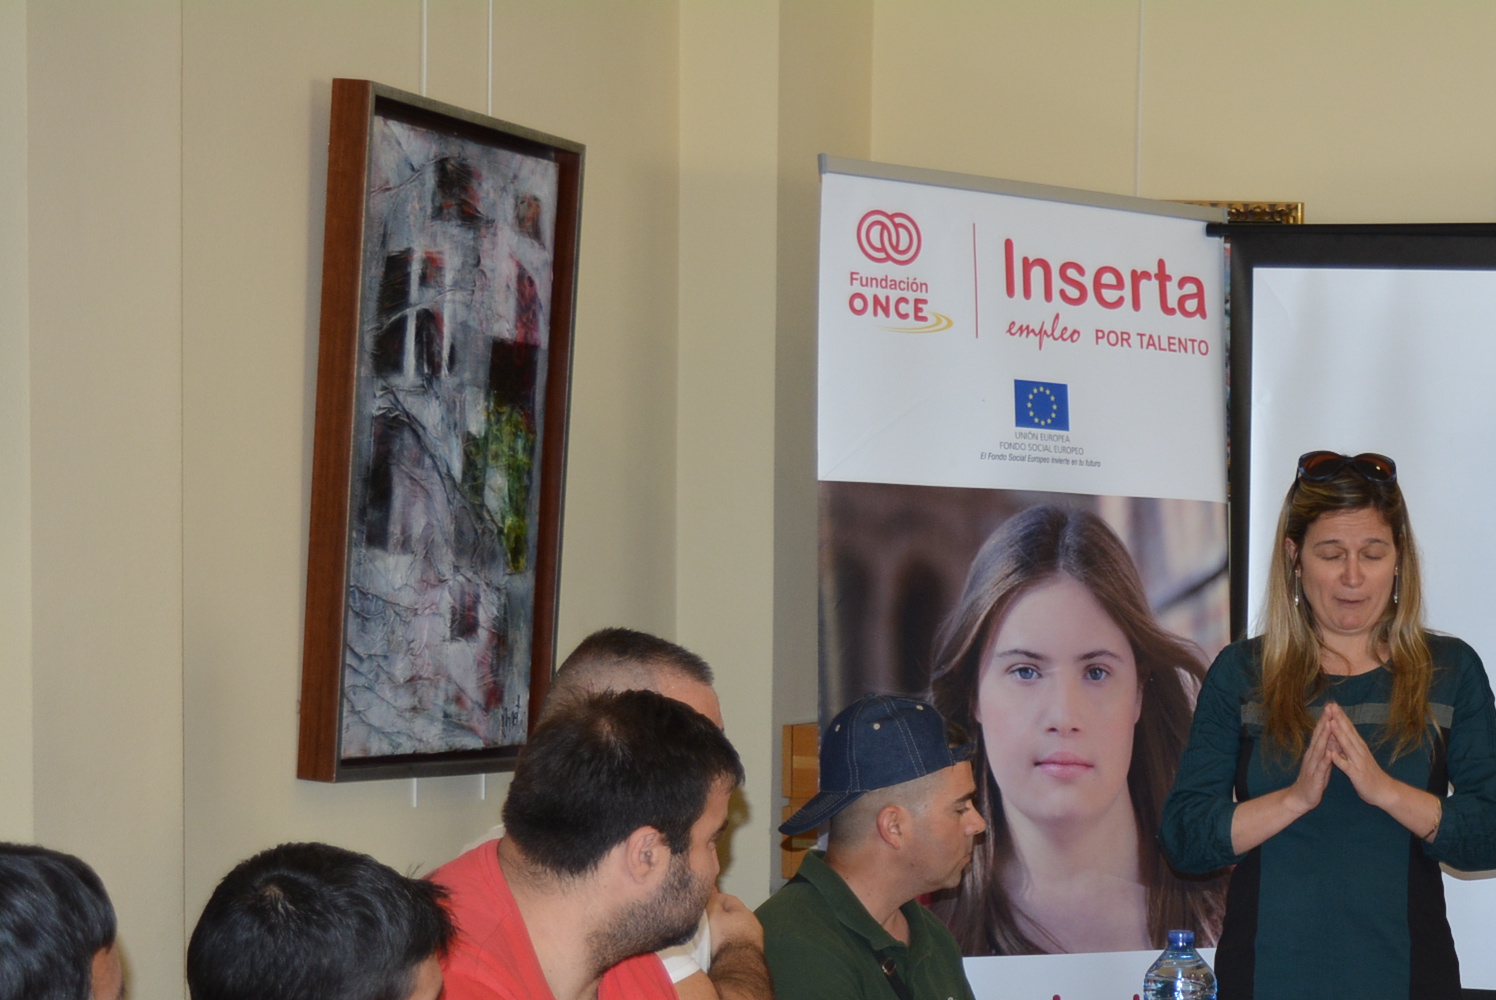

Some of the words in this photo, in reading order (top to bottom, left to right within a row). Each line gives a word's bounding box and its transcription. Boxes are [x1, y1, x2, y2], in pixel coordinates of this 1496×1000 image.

[849, 271, 929, 294] Fundación
[1003, 238, 1208, 321] Inserta
[848, 291, 929, 323] ONCE
[1005, 313, 1081, 351] empleo
[1094, 328, 1132, 348] POR
[1137, 331, 1210, 357] TALENTO
[999, 441, 1026, 452] FONDO
[1027, 443, 1052, 454] SOCIAL
[1053, 445, 1085, 456] EUROPEO
[1014, 430, 1039, 441] UNIÓN
[1039, 432, 1071, 444] EUROPEA
[987, 452, 1008, 462] Fondo
[1008, 453, 1026, 463] Social
[1027, 454, 1051, 465] Europeo
